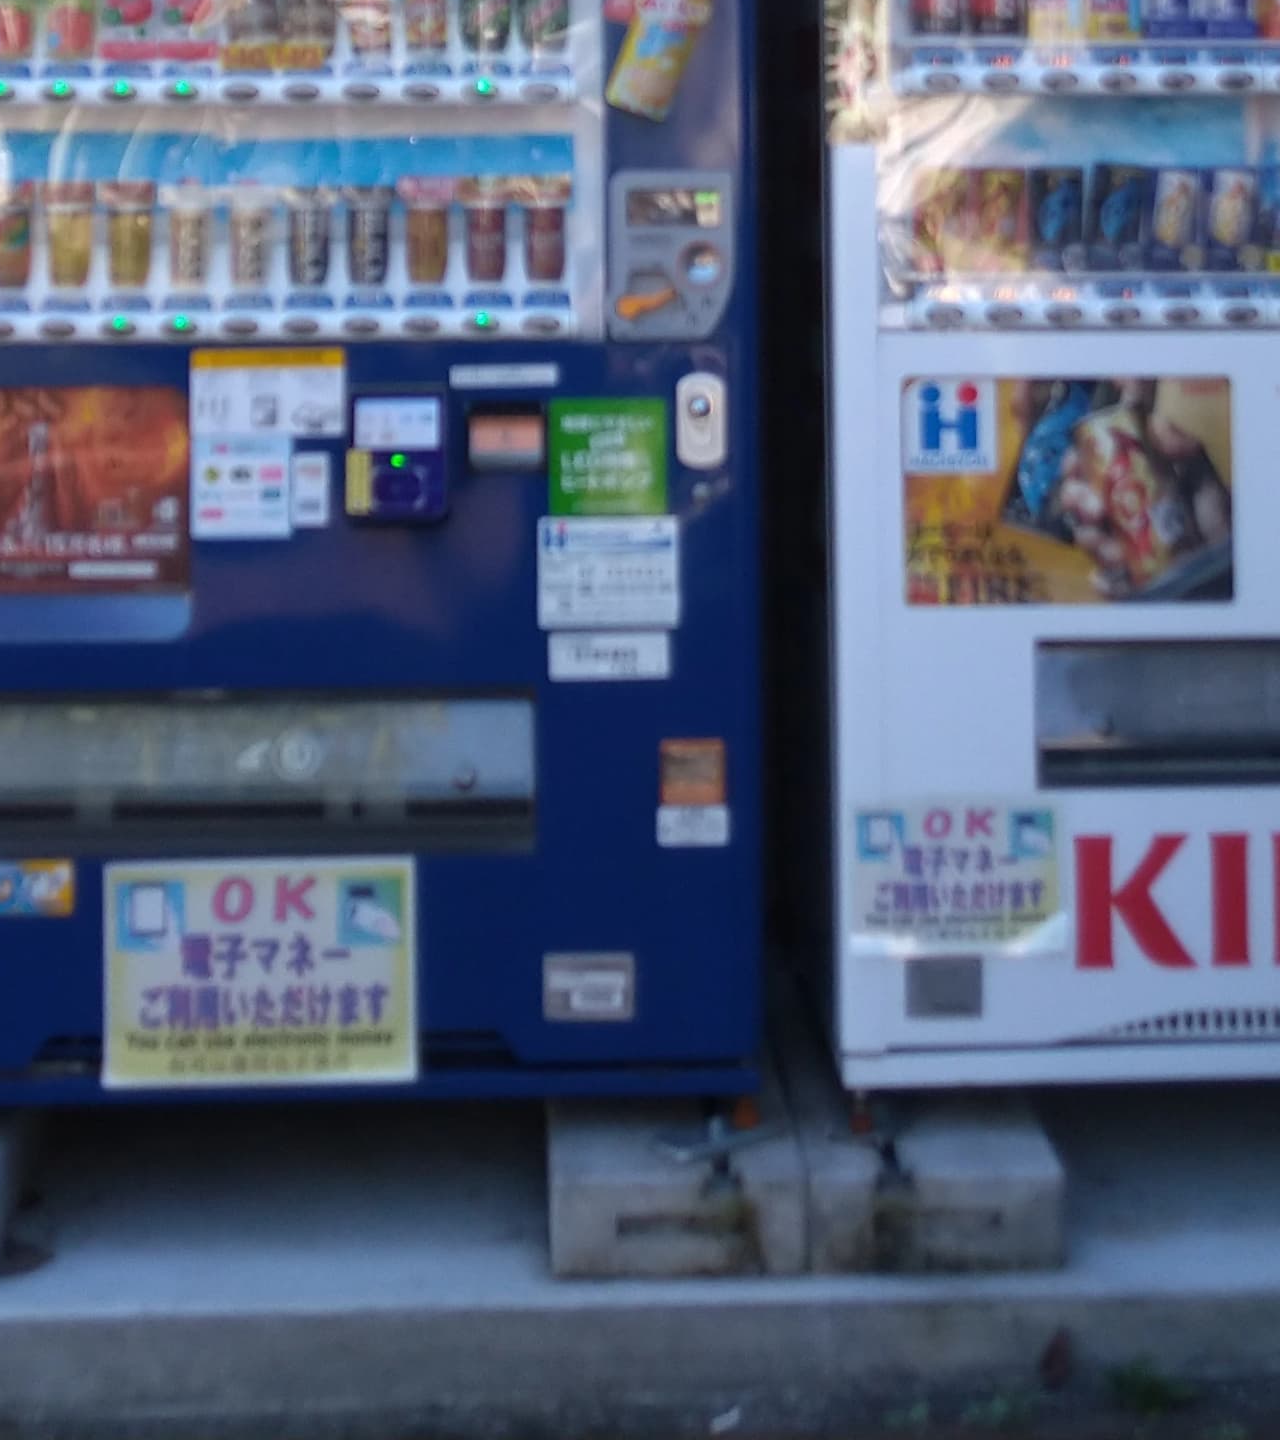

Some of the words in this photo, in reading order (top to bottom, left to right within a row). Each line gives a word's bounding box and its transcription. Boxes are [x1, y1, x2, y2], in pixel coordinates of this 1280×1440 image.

[179, 932, 352, 980] 電子マネー
[138, 982, 390, 1031] ご利用いただけます
